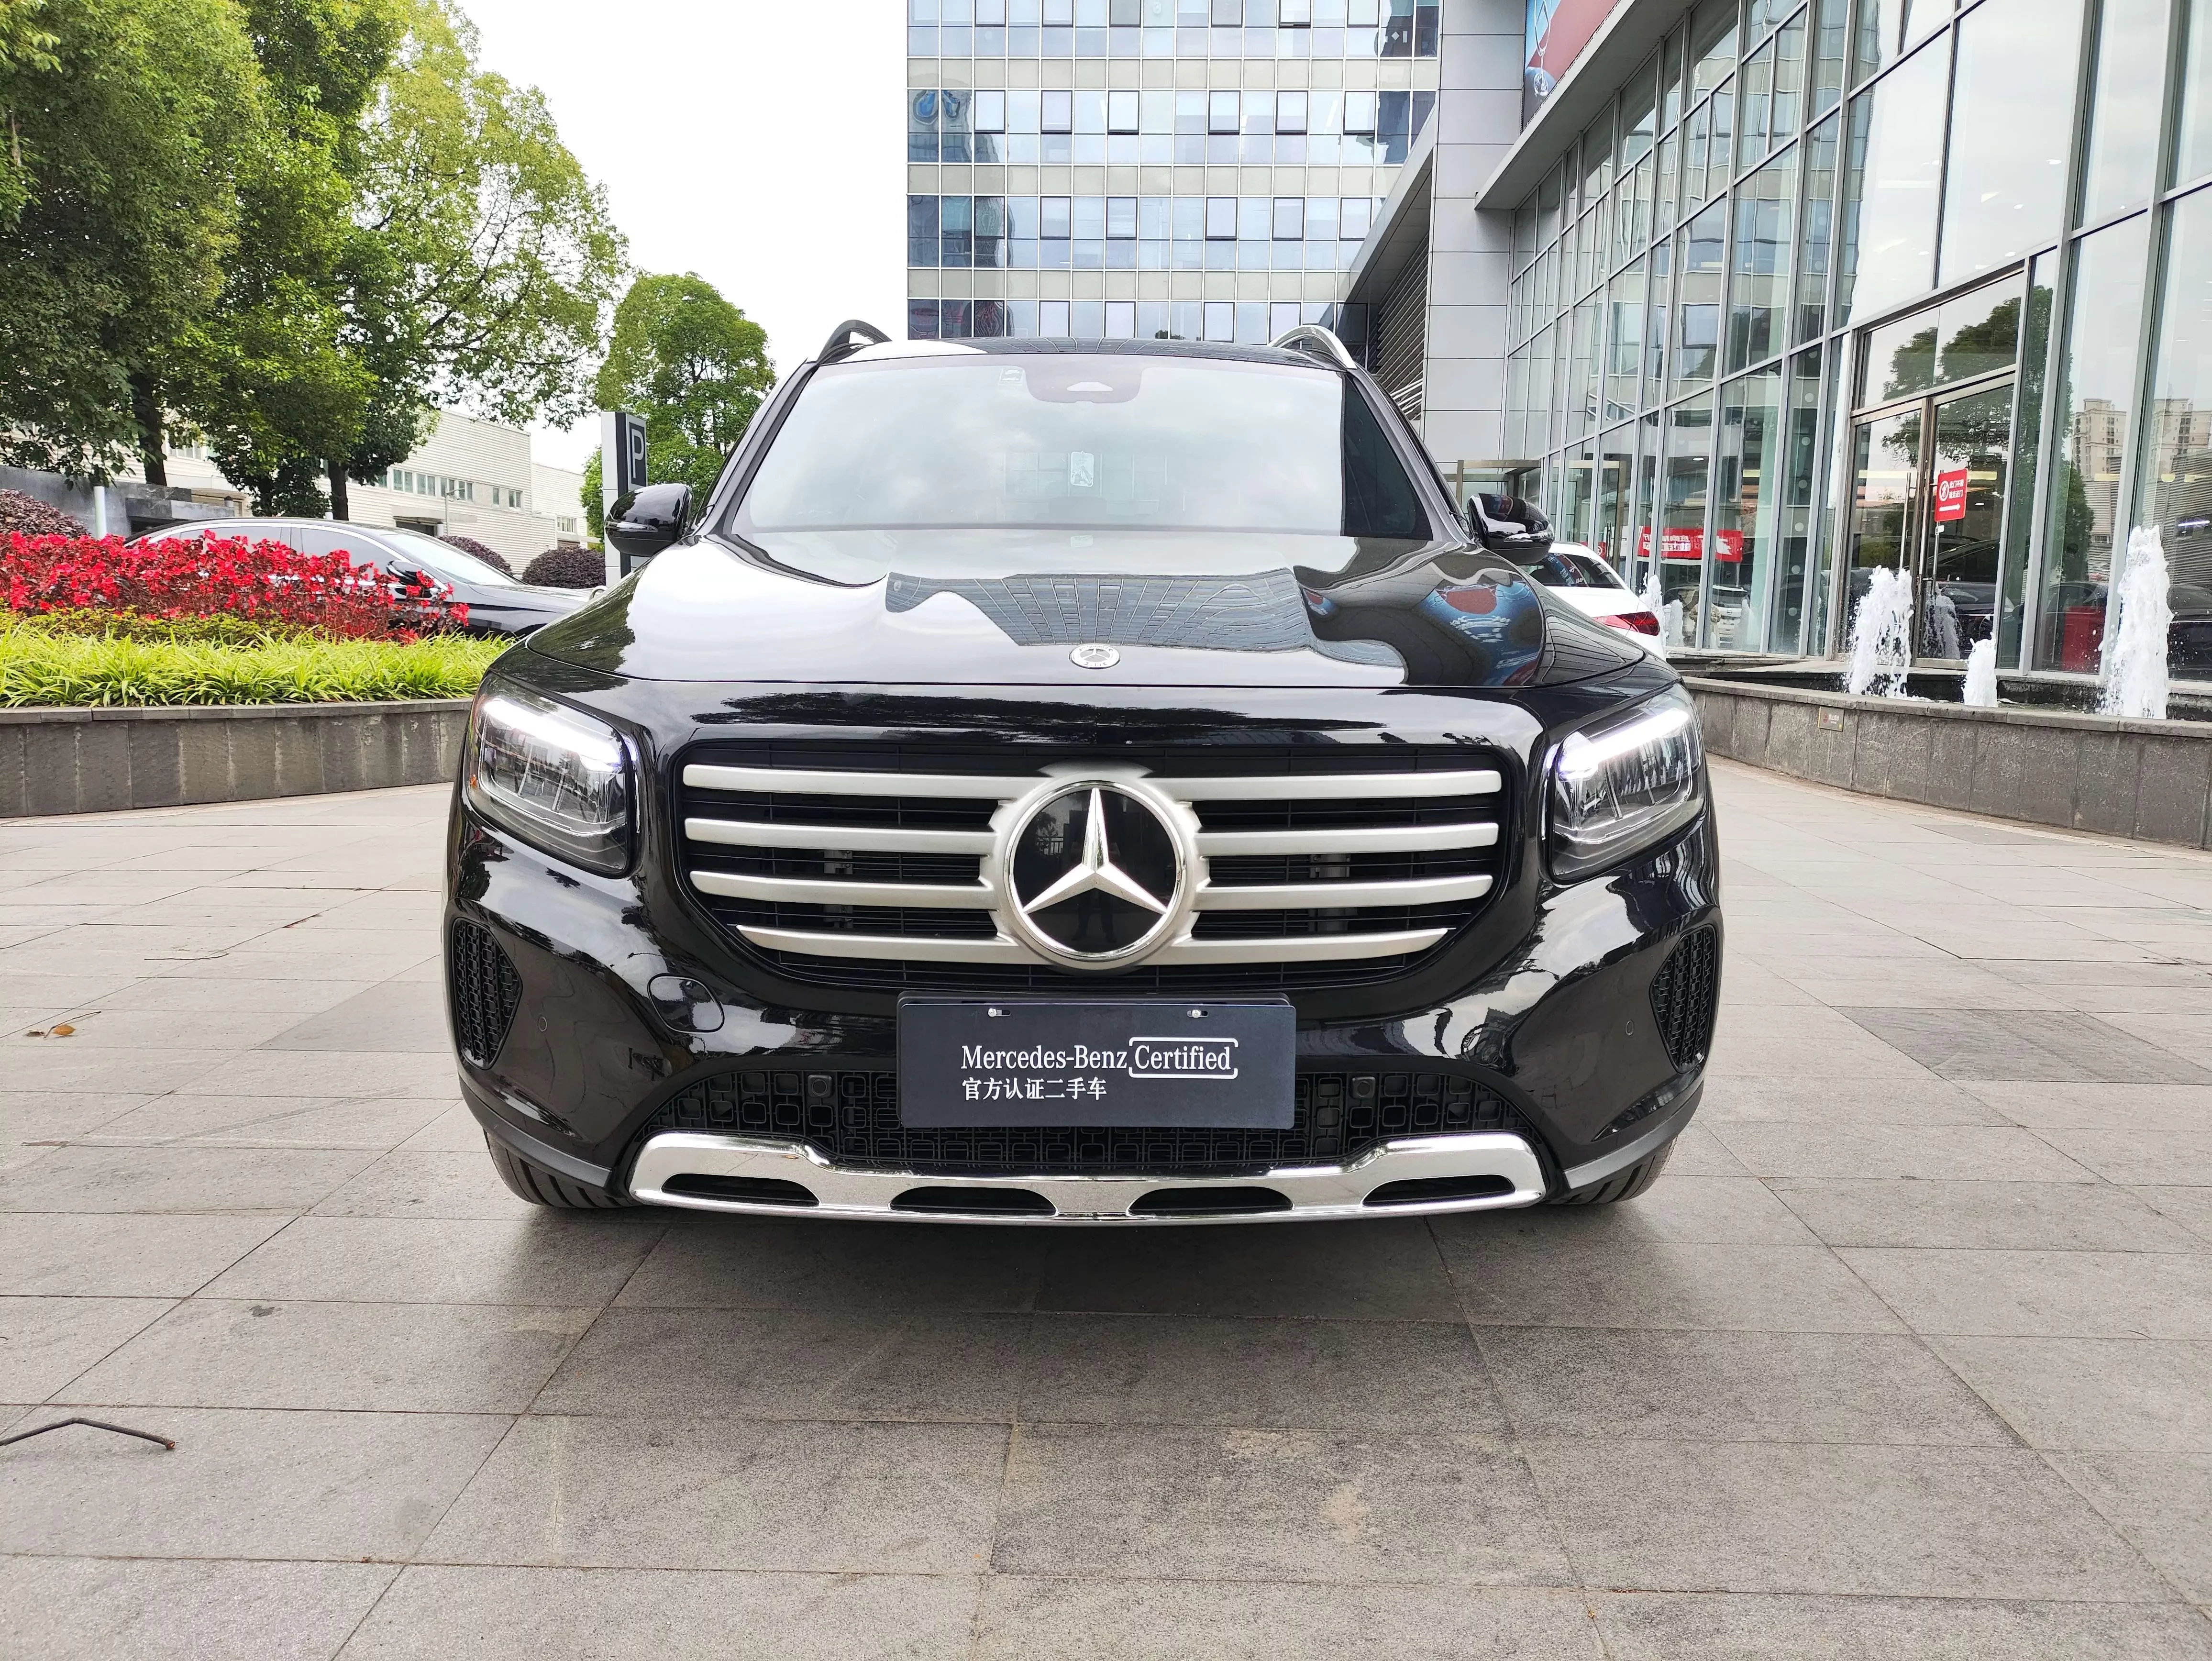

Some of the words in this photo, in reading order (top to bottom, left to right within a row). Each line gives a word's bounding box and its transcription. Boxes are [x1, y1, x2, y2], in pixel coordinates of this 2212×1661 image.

[631, 429, 644, 478] P
[961, 1045, 1128, 1069] Mercedes-Benz
[1135, 1045, 1231, 1070] Certified
[962, 1076, 1107, 1101] 官方认证二手车
